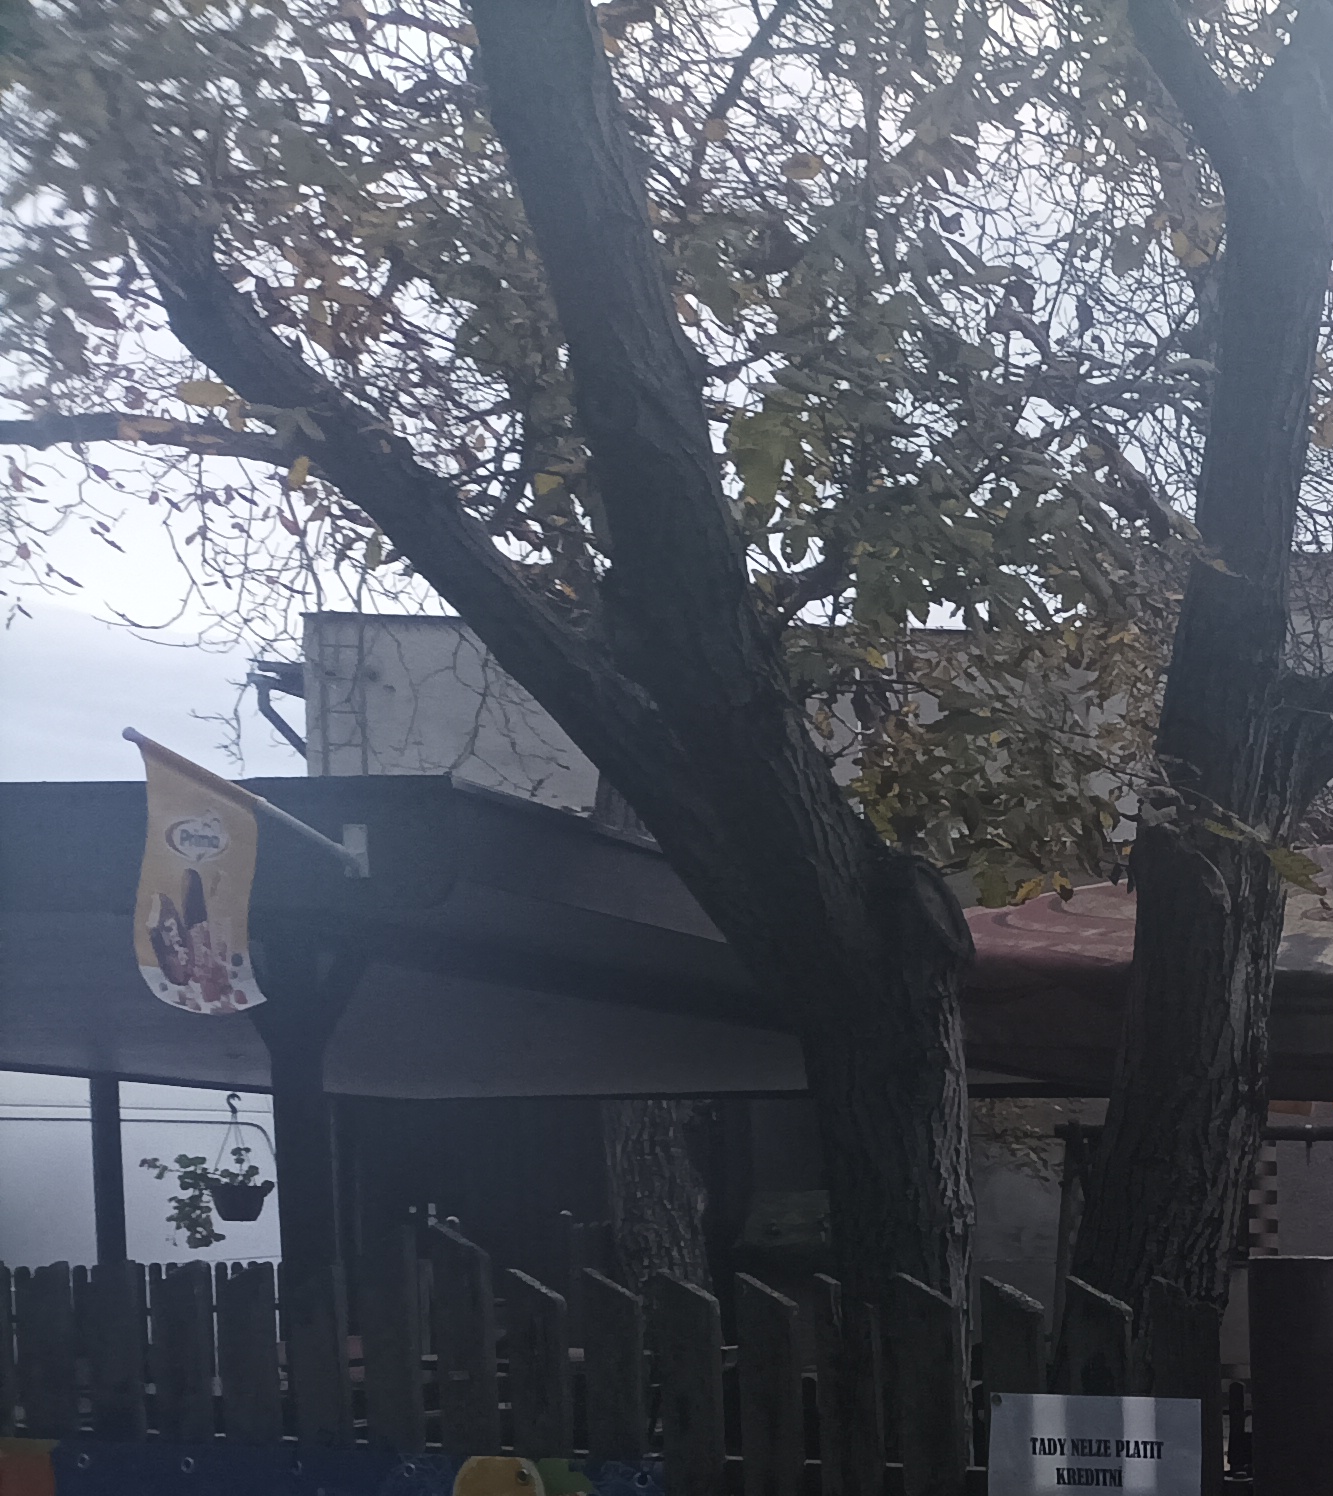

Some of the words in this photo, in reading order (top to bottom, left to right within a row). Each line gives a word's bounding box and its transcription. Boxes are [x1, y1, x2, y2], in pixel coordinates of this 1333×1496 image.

[1030, 1437, 1066, 1456] TADY
[1070, 1438, 1111, 1457] NELZE
[1115, 1439, 1164, 1459] PLATIT
[1056, 1465, 1123, 1487] KREDITNÍ
